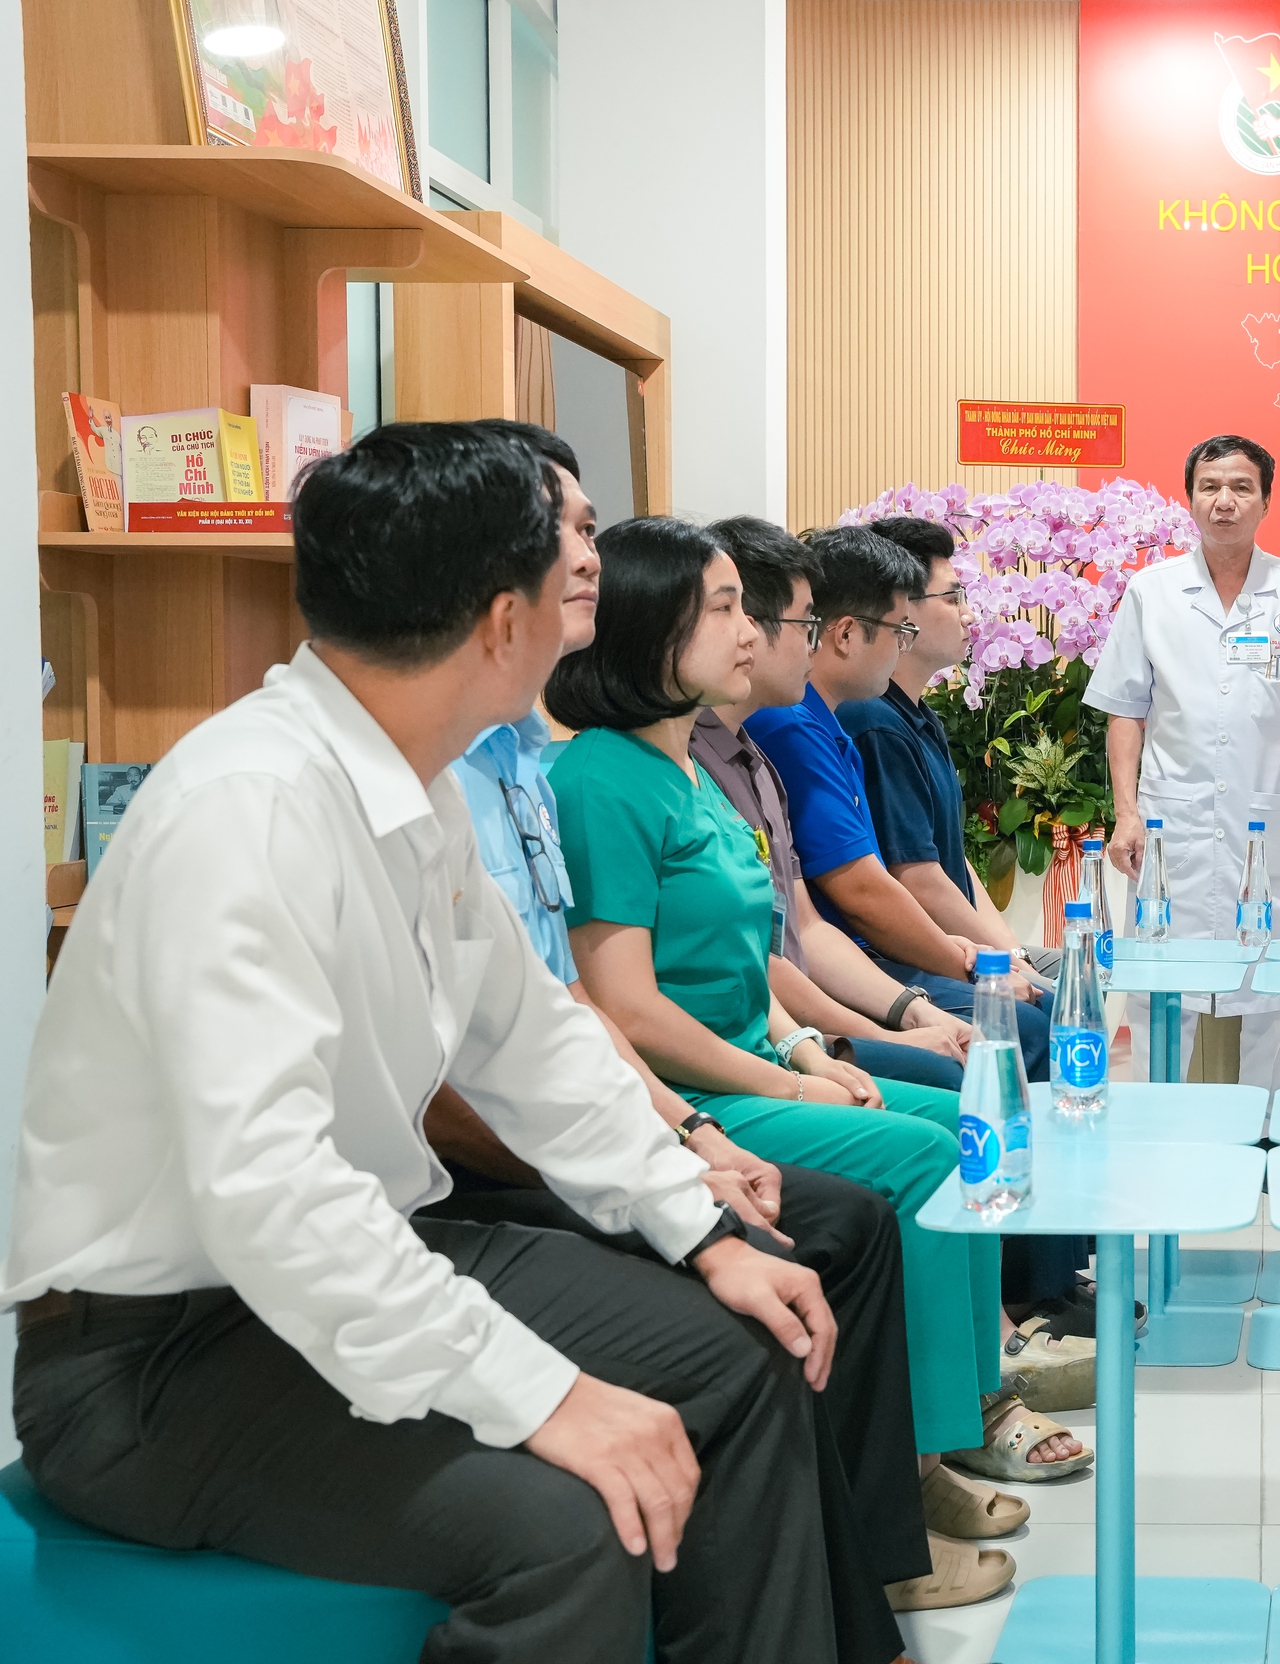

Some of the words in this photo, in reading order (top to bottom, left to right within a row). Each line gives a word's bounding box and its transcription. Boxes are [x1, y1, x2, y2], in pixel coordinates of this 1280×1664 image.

[171, 434, 182, 443] DI
[185, 429, 214, 441] CHÚC
[986, 426, 1017, 437] THÀNH
[1019, 426, 1037, 437] PHỐ
[1055, 428, 1070, 439] CHÍ
[1073, 430, 1096, 439] MINH
[172, 444, 185, 452] CỦA
[187, 441, 200, 450] CHỦ
[202, 442, 215, 451] TỊCH
[1000, 438, 1035, 455] Chúc
[1038, 440, 1081, 463] Mừng
[186, 452, 204, 468] Hồ
[185, 468, 207, 481] Chí
[179, 482, 214, 495] Minh
[99, 832, 114, 842] Ng
[1101, 938, 1113, 954] IC
[1067, 1042, 1102, 1067] ICY
[960, 1127, 991, 1157] CY
